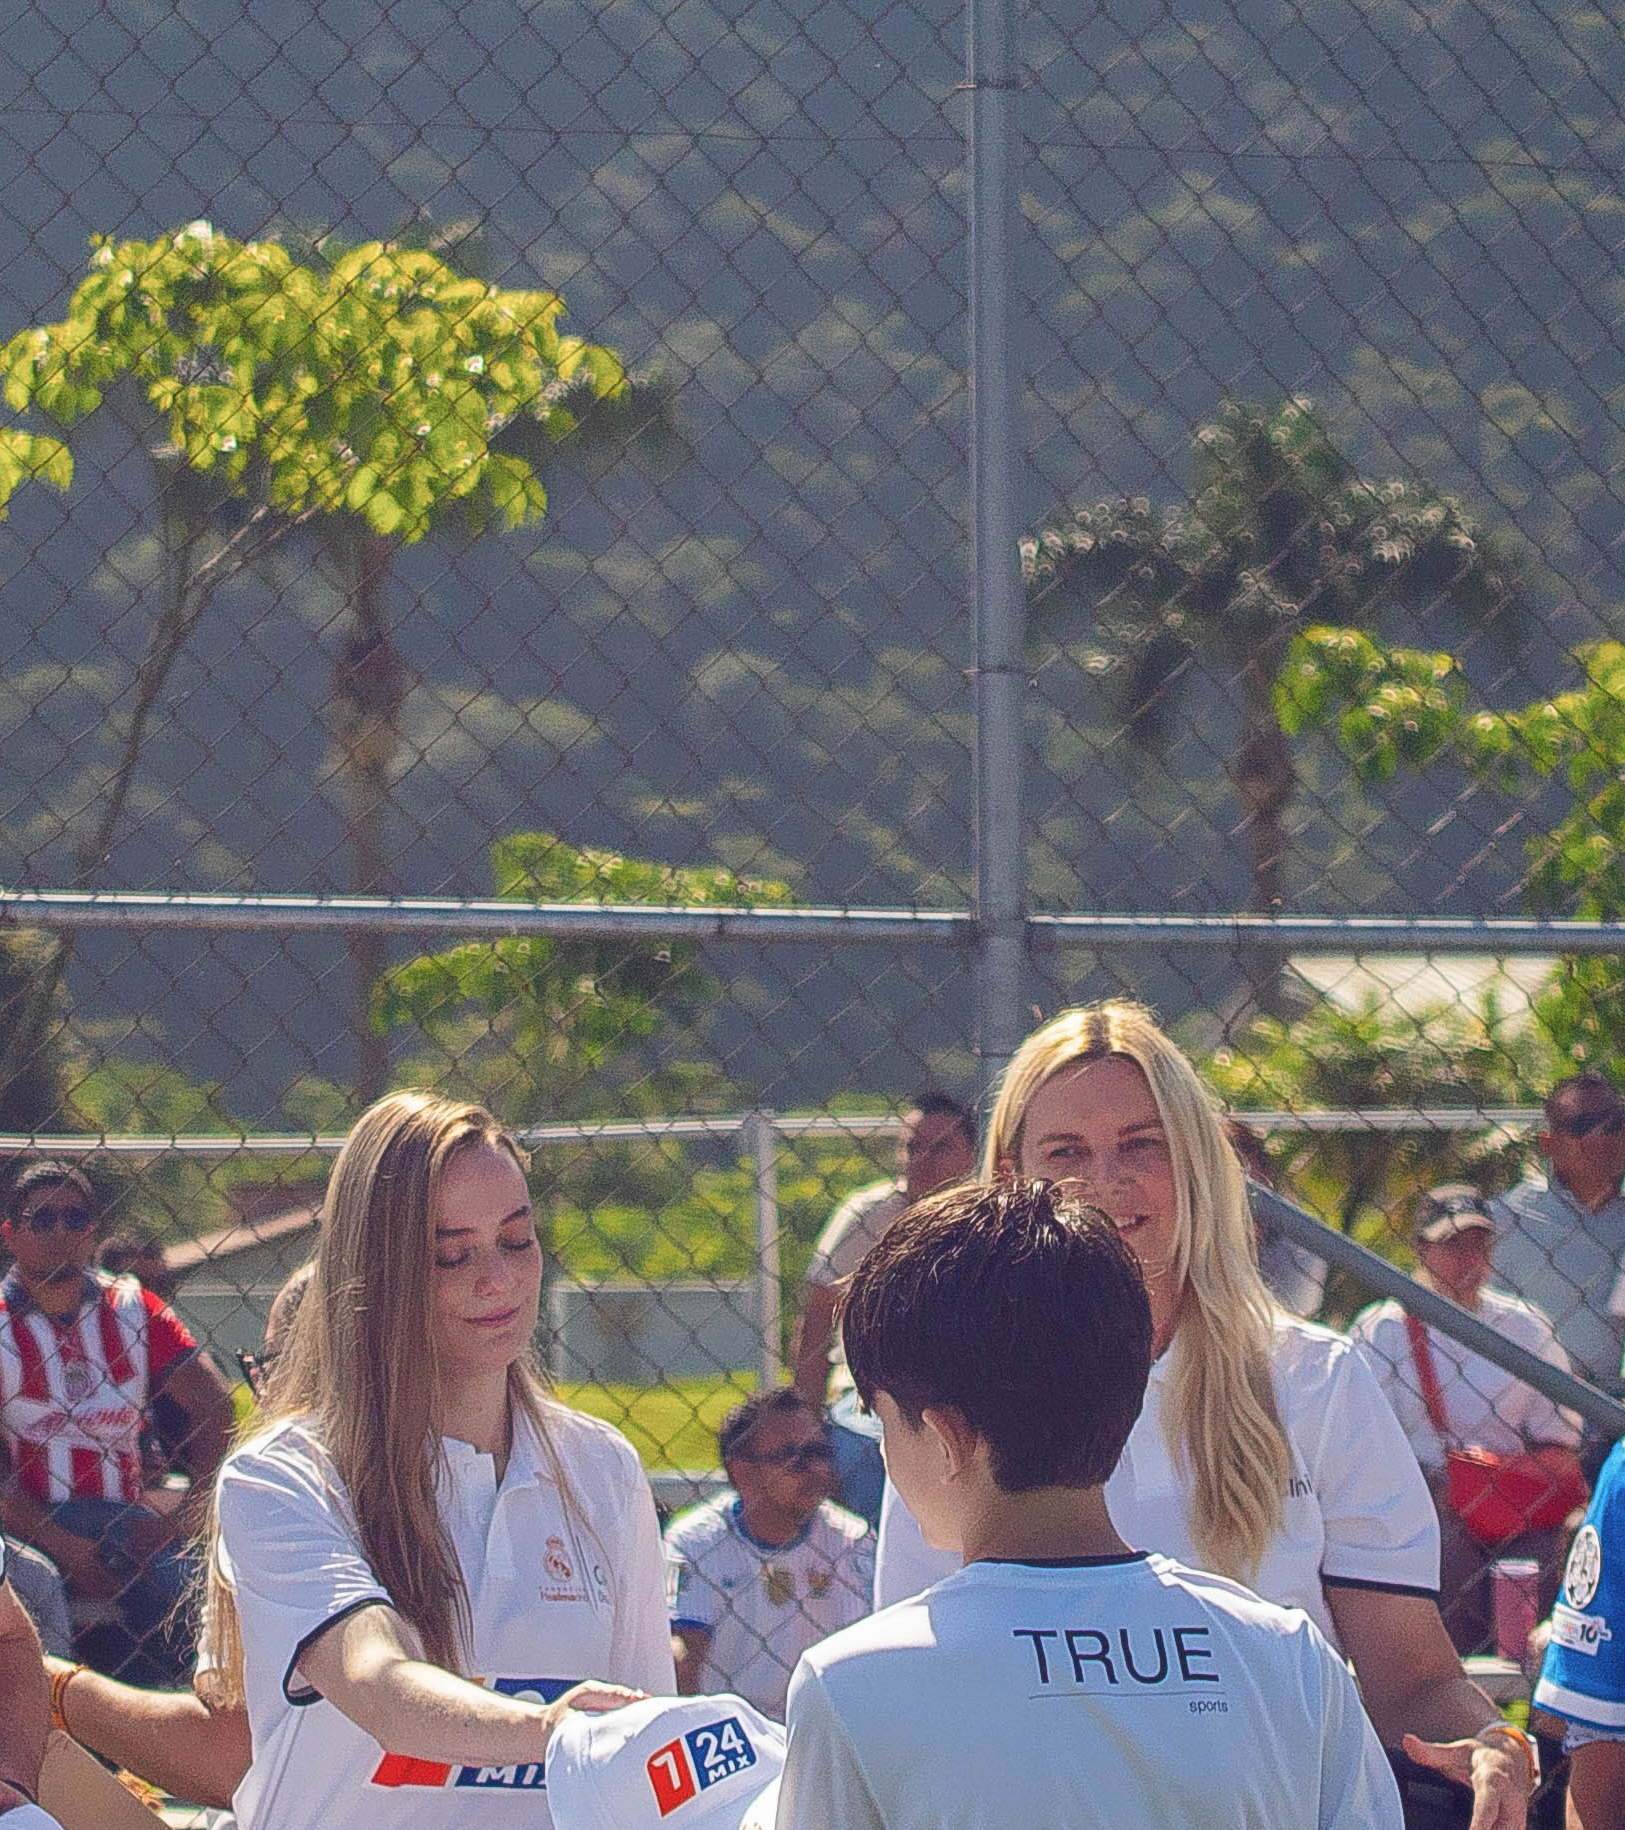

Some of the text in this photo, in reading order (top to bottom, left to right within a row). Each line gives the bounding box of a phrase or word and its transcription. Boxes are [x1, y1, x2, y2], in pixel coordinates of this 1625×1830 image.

[1012, 1627, 1220, 1685] TRUE
[1189, 1700, 1229, 1714] sports
[696, 1722, 745, 1768] 24
[475, 1765, 545, 1785] MI
[708, 1755, 751, 1784] MIX
